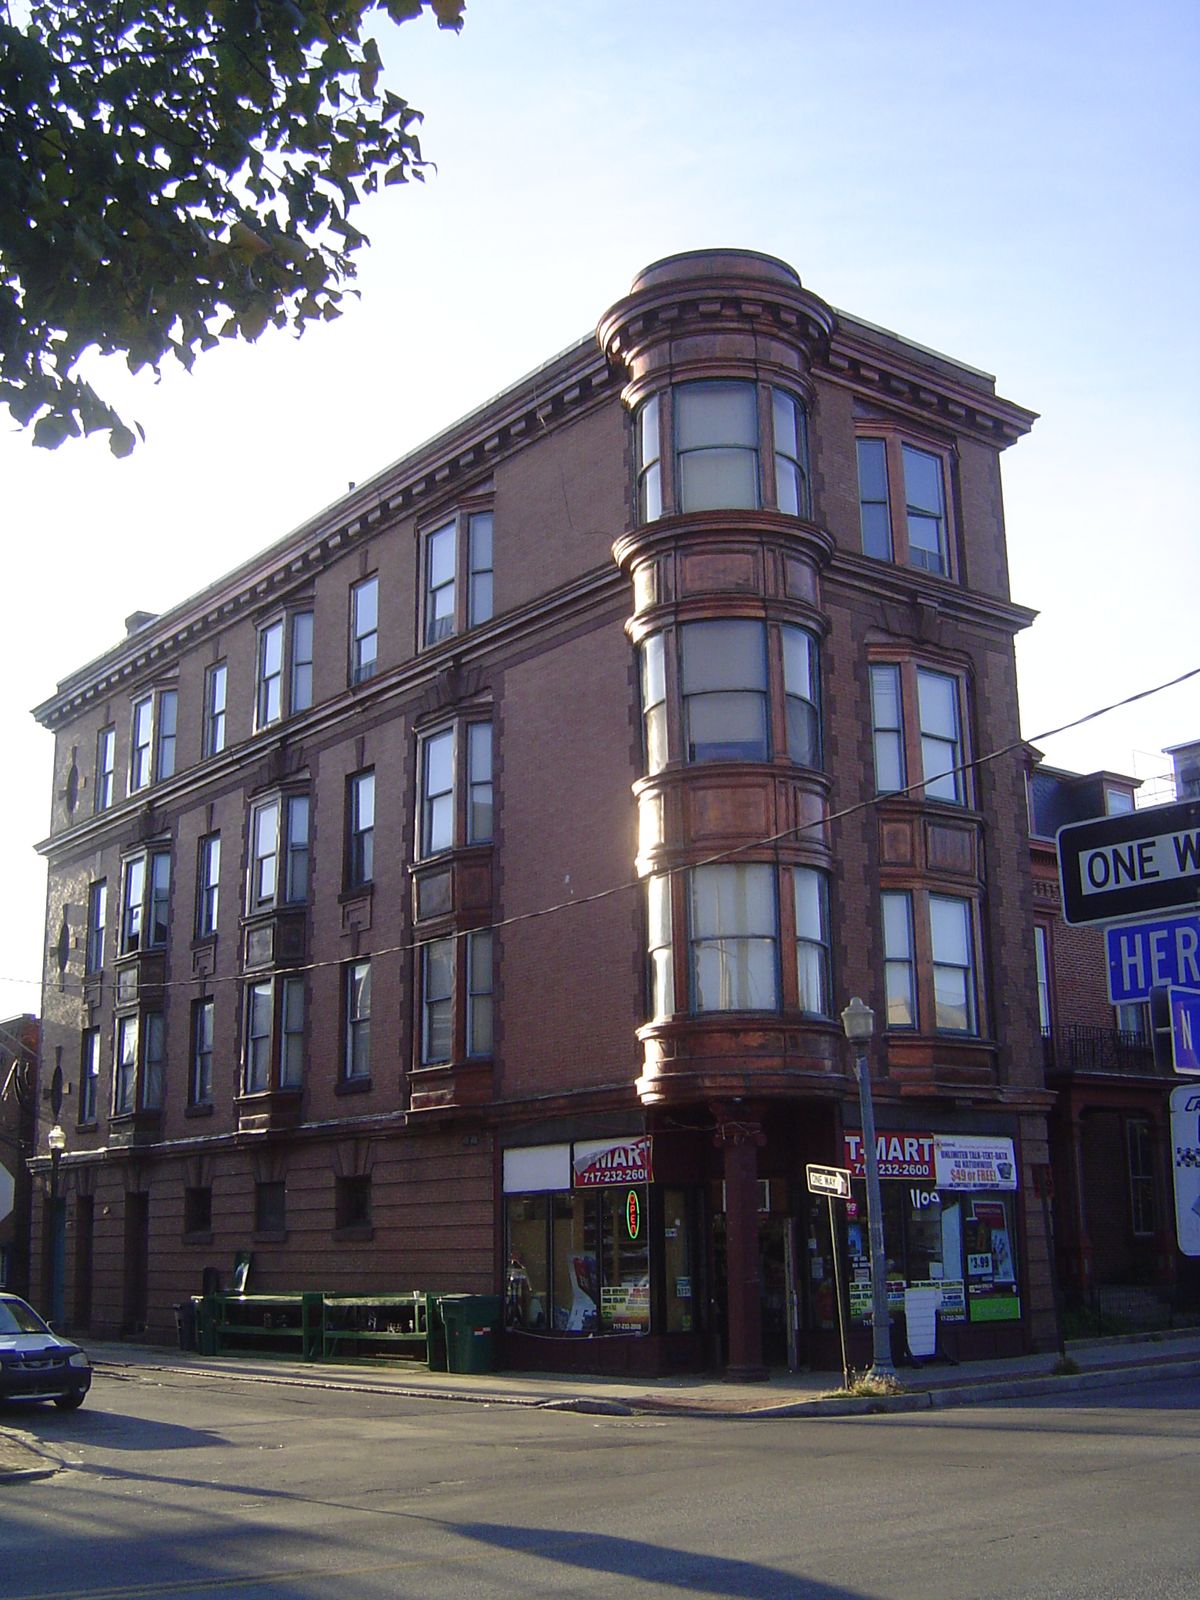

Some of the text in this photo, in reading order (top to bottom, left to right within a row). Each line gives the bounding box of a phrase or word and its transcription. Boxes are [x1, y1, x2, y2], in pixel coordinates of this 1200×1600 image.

[1087, 841, 1160, 889] ONE
[1180, 1008, 1193, 1050] N
[811, 1173, 837, 1187] ONE WAY
[950, 1168, 997, 1182] $49 or FREE!
[628, 1194, 637, 1235] OPEN
